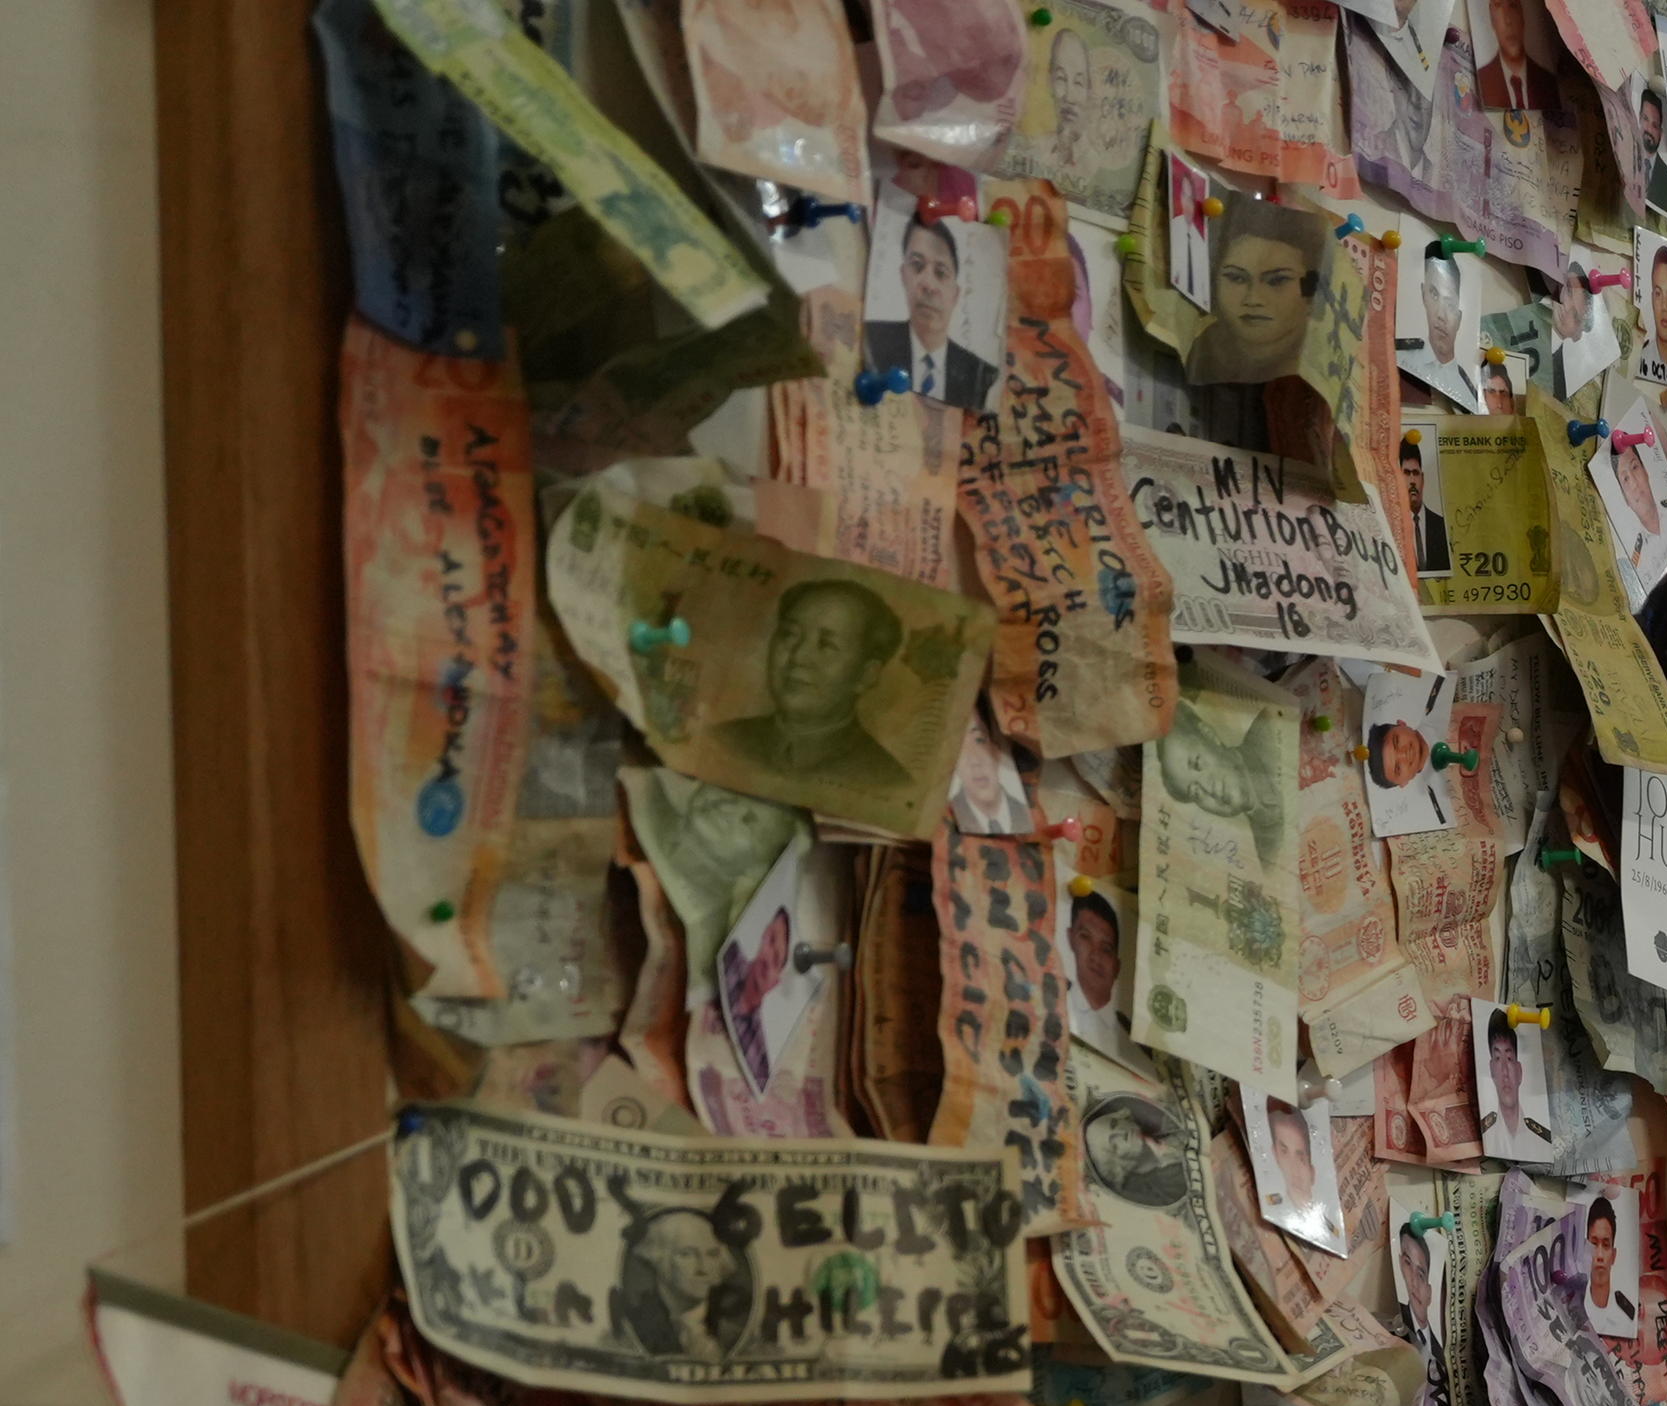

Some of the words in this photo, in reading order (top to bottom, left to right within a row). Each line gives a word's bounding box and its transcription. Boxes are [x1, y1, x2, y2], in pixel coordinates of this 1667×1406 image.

[1462, 435, 1492, 448] BANK
[1458, 550, 1509, 577] ₹20
[1462, 581, 1532, 603] 497930
